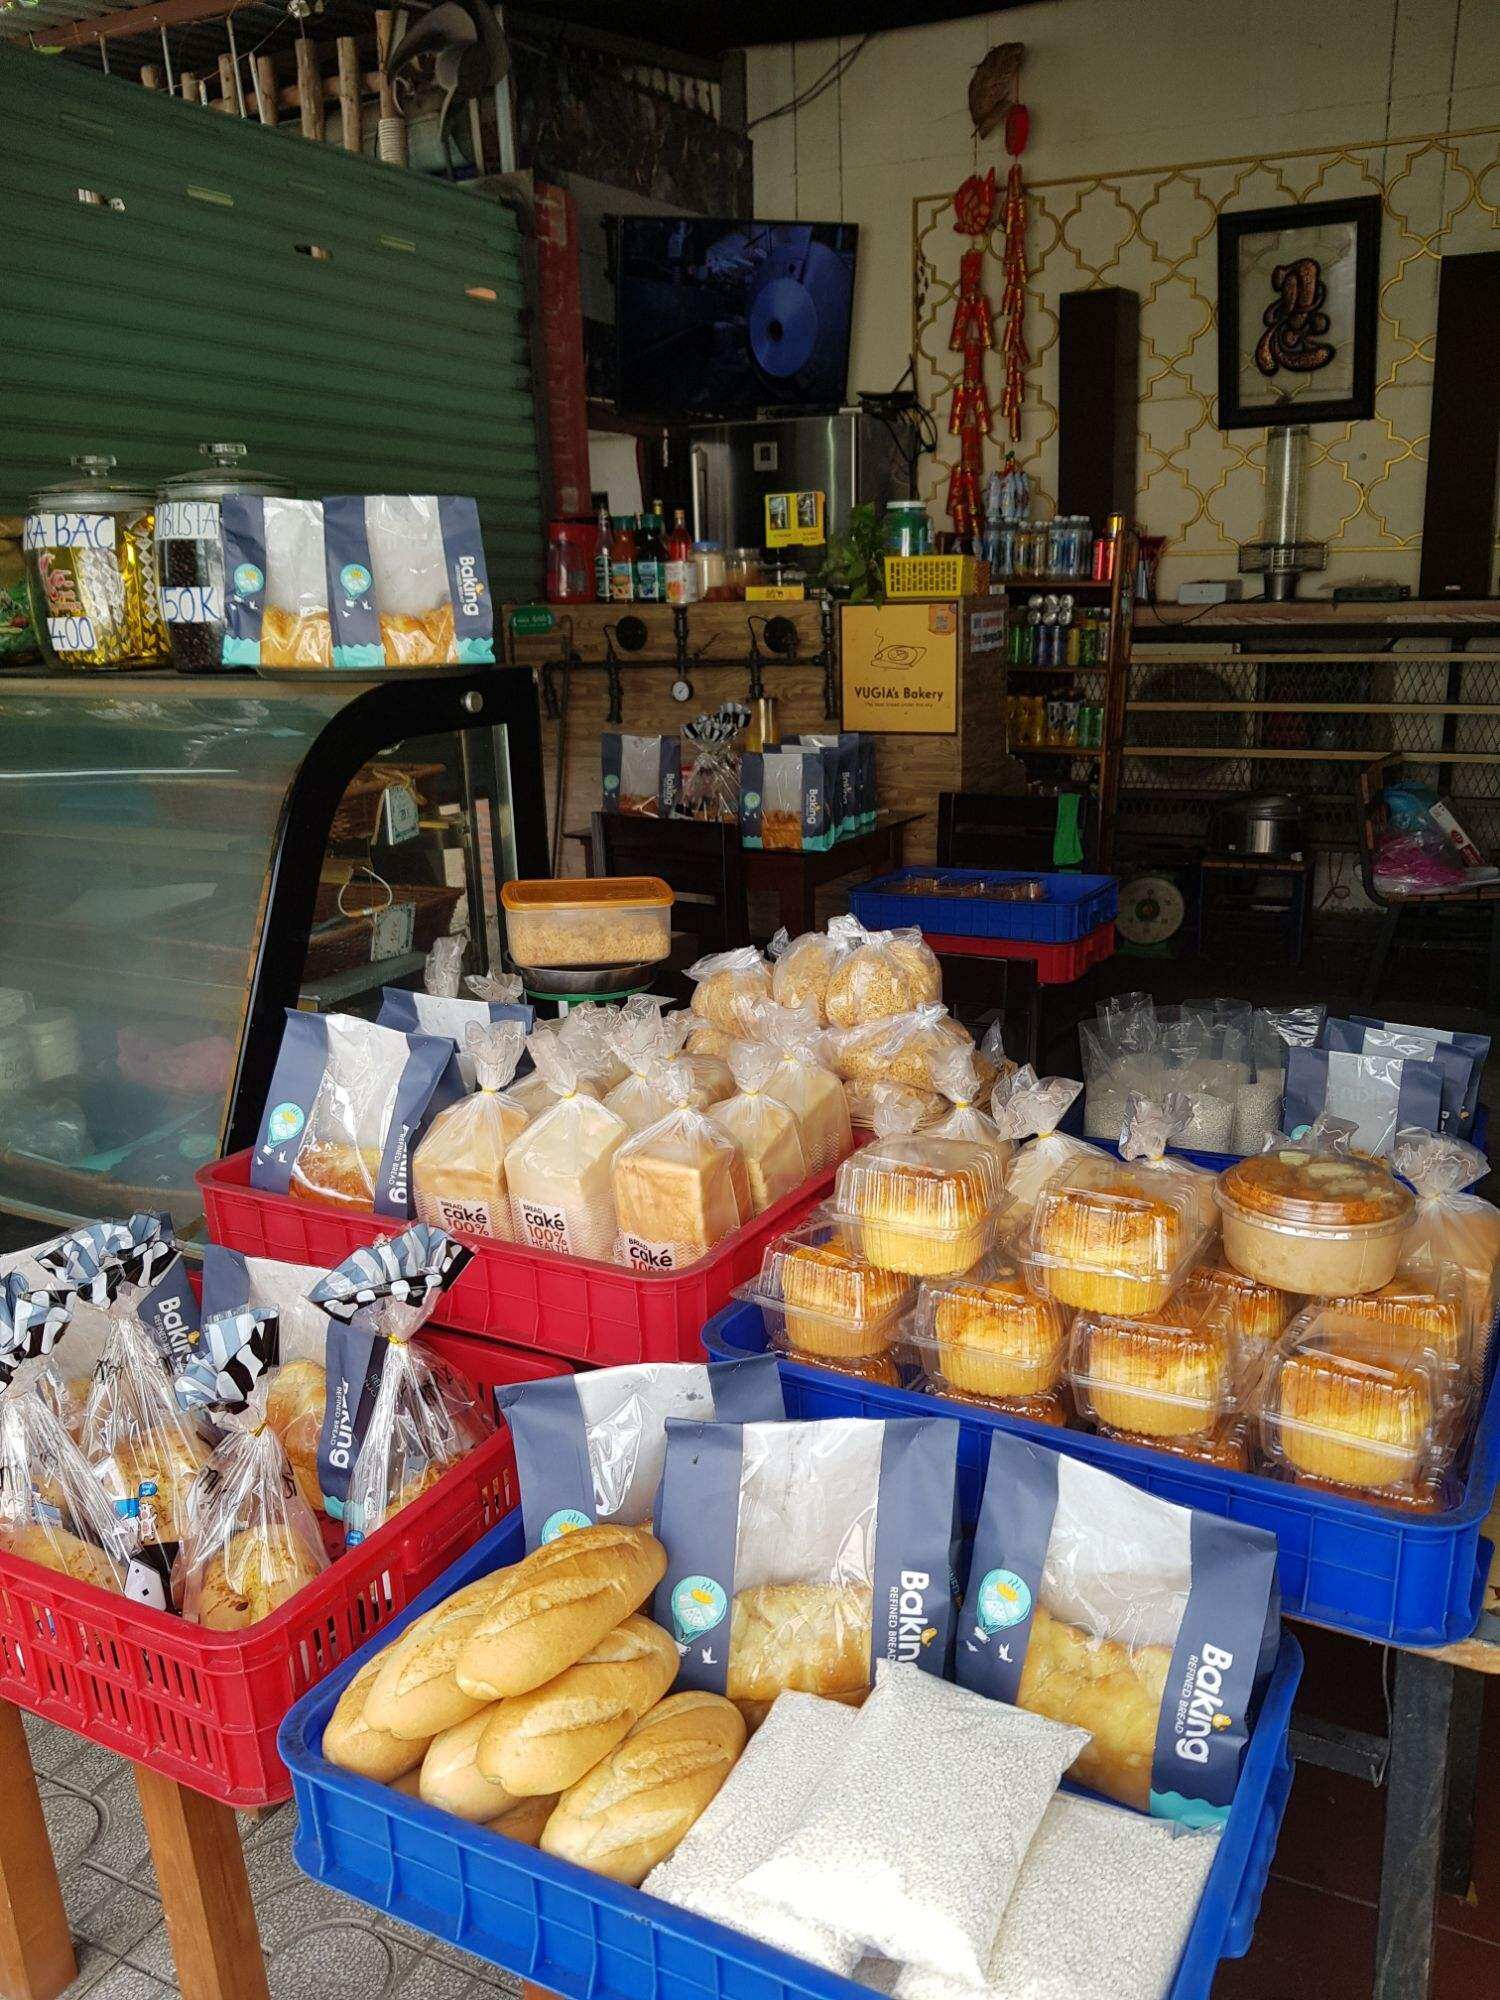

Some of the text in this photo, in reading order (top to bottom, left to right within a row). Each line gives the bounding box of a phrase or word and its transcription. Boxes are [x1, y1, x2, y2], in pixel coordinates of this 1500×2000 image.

[156, 502, 218, 537] OBUSTA
[459, 556, 480, 616] Baking
[903, 686, 944, 702] Bakery
[806, 788, 820, 825] Baking
[388, 1162, 399, 1185] BREAD
[443, 1207, 487, 1224] caké
[525, 1212, 565, 1231] caké
[527, 1225, 568, 1246] 100%
[629, 1246, 673, 1267] caké
[158, 1296, 192, 1355] Bakin
[330, 1420, 340, 1446] BREAD
[887, 1586, 898, 1660] REFINED BREAD
[898, 1570, 930, 1661] Bakin
[1174, 1654, 1199, 1734] REFINED BREAD
[1174, 1643, 1234, 1764] Baking
